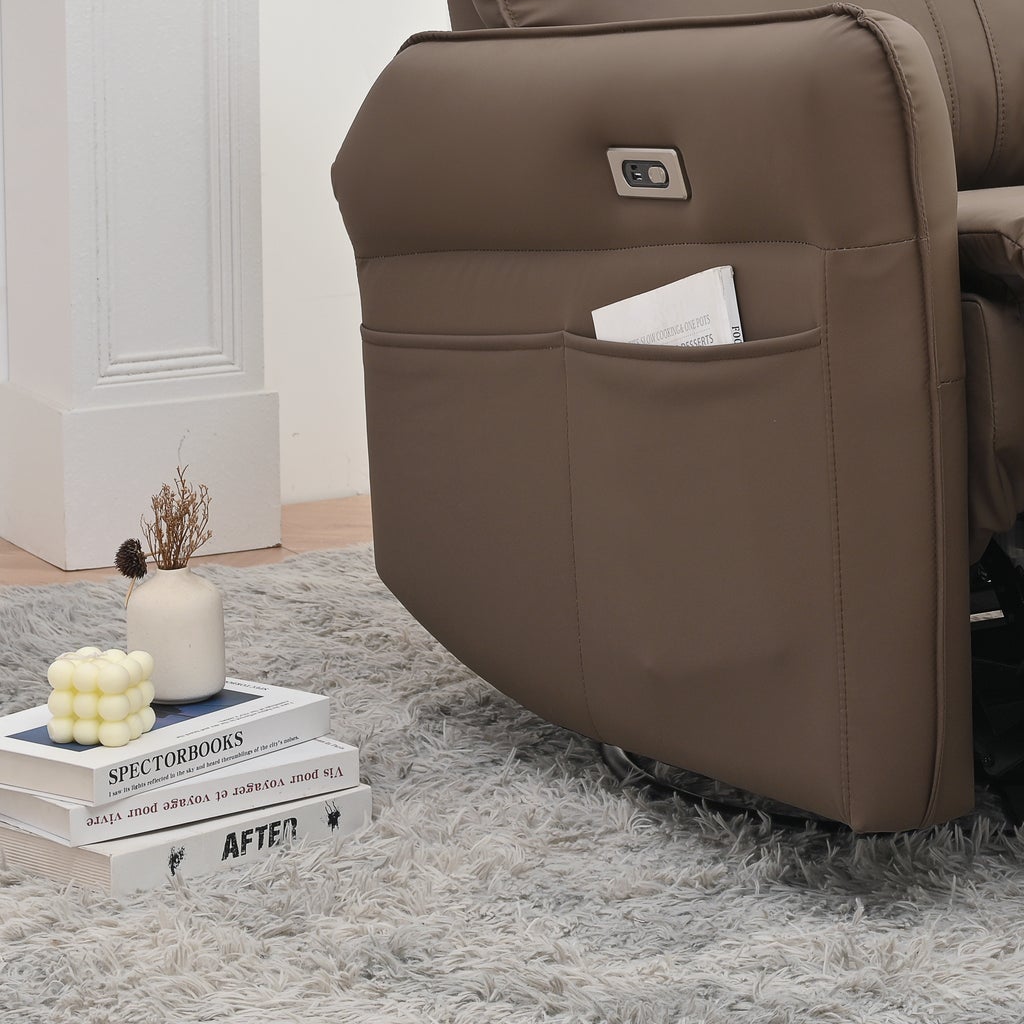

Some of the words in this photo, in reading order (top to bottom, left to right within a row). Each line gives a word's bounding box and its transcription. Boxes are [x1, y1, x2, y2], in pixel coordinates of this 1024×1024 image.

[684, 318, 696, 332] ONE
[696, 314, 711, 328] POTS
[108, 730, 244, 785] SPECTORBOOKS
[131, 782, 146, 791] lights
[147, 774, 170, 787] reflected
[186, 765, 195, 774] sky
[196, 762, 206, 771] and
[206, 758, 221, 767] heard
[289, 768, 320, 784] pour
[323, 766, 344, 778] Vis
[215, 789, 228, 802] et
[232, 778, 285, 796] voyager
[127, 802, 158, 818] pour
[163, 793, 211, 811] voyage
[86, 812, 123, 827] vivre
[221, 817, 298, 861] AFTER
